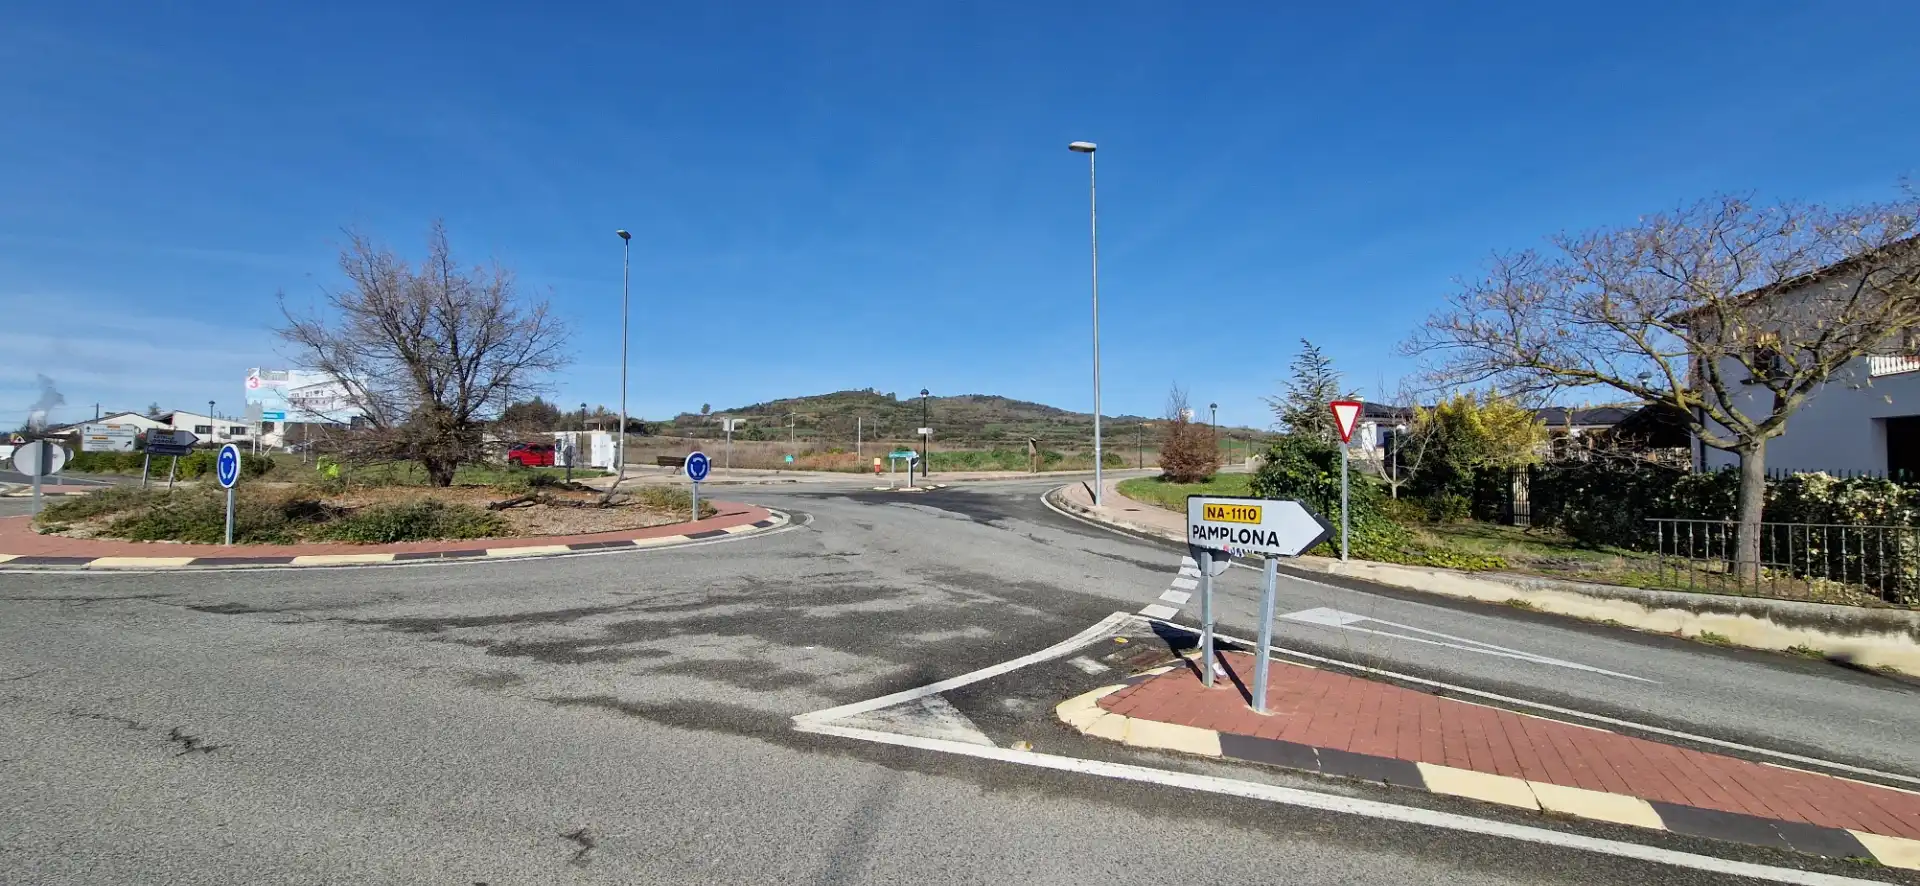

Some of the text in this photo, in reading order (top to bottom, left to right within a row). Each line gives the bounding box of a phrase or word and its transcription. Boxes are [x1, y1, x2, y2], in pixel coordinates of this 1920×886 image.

[249, 376, 259, 389] 3
[1207, 506, 1257, 520] NA-1110
[1192, 525, 1280, 547] PAMPLONA
